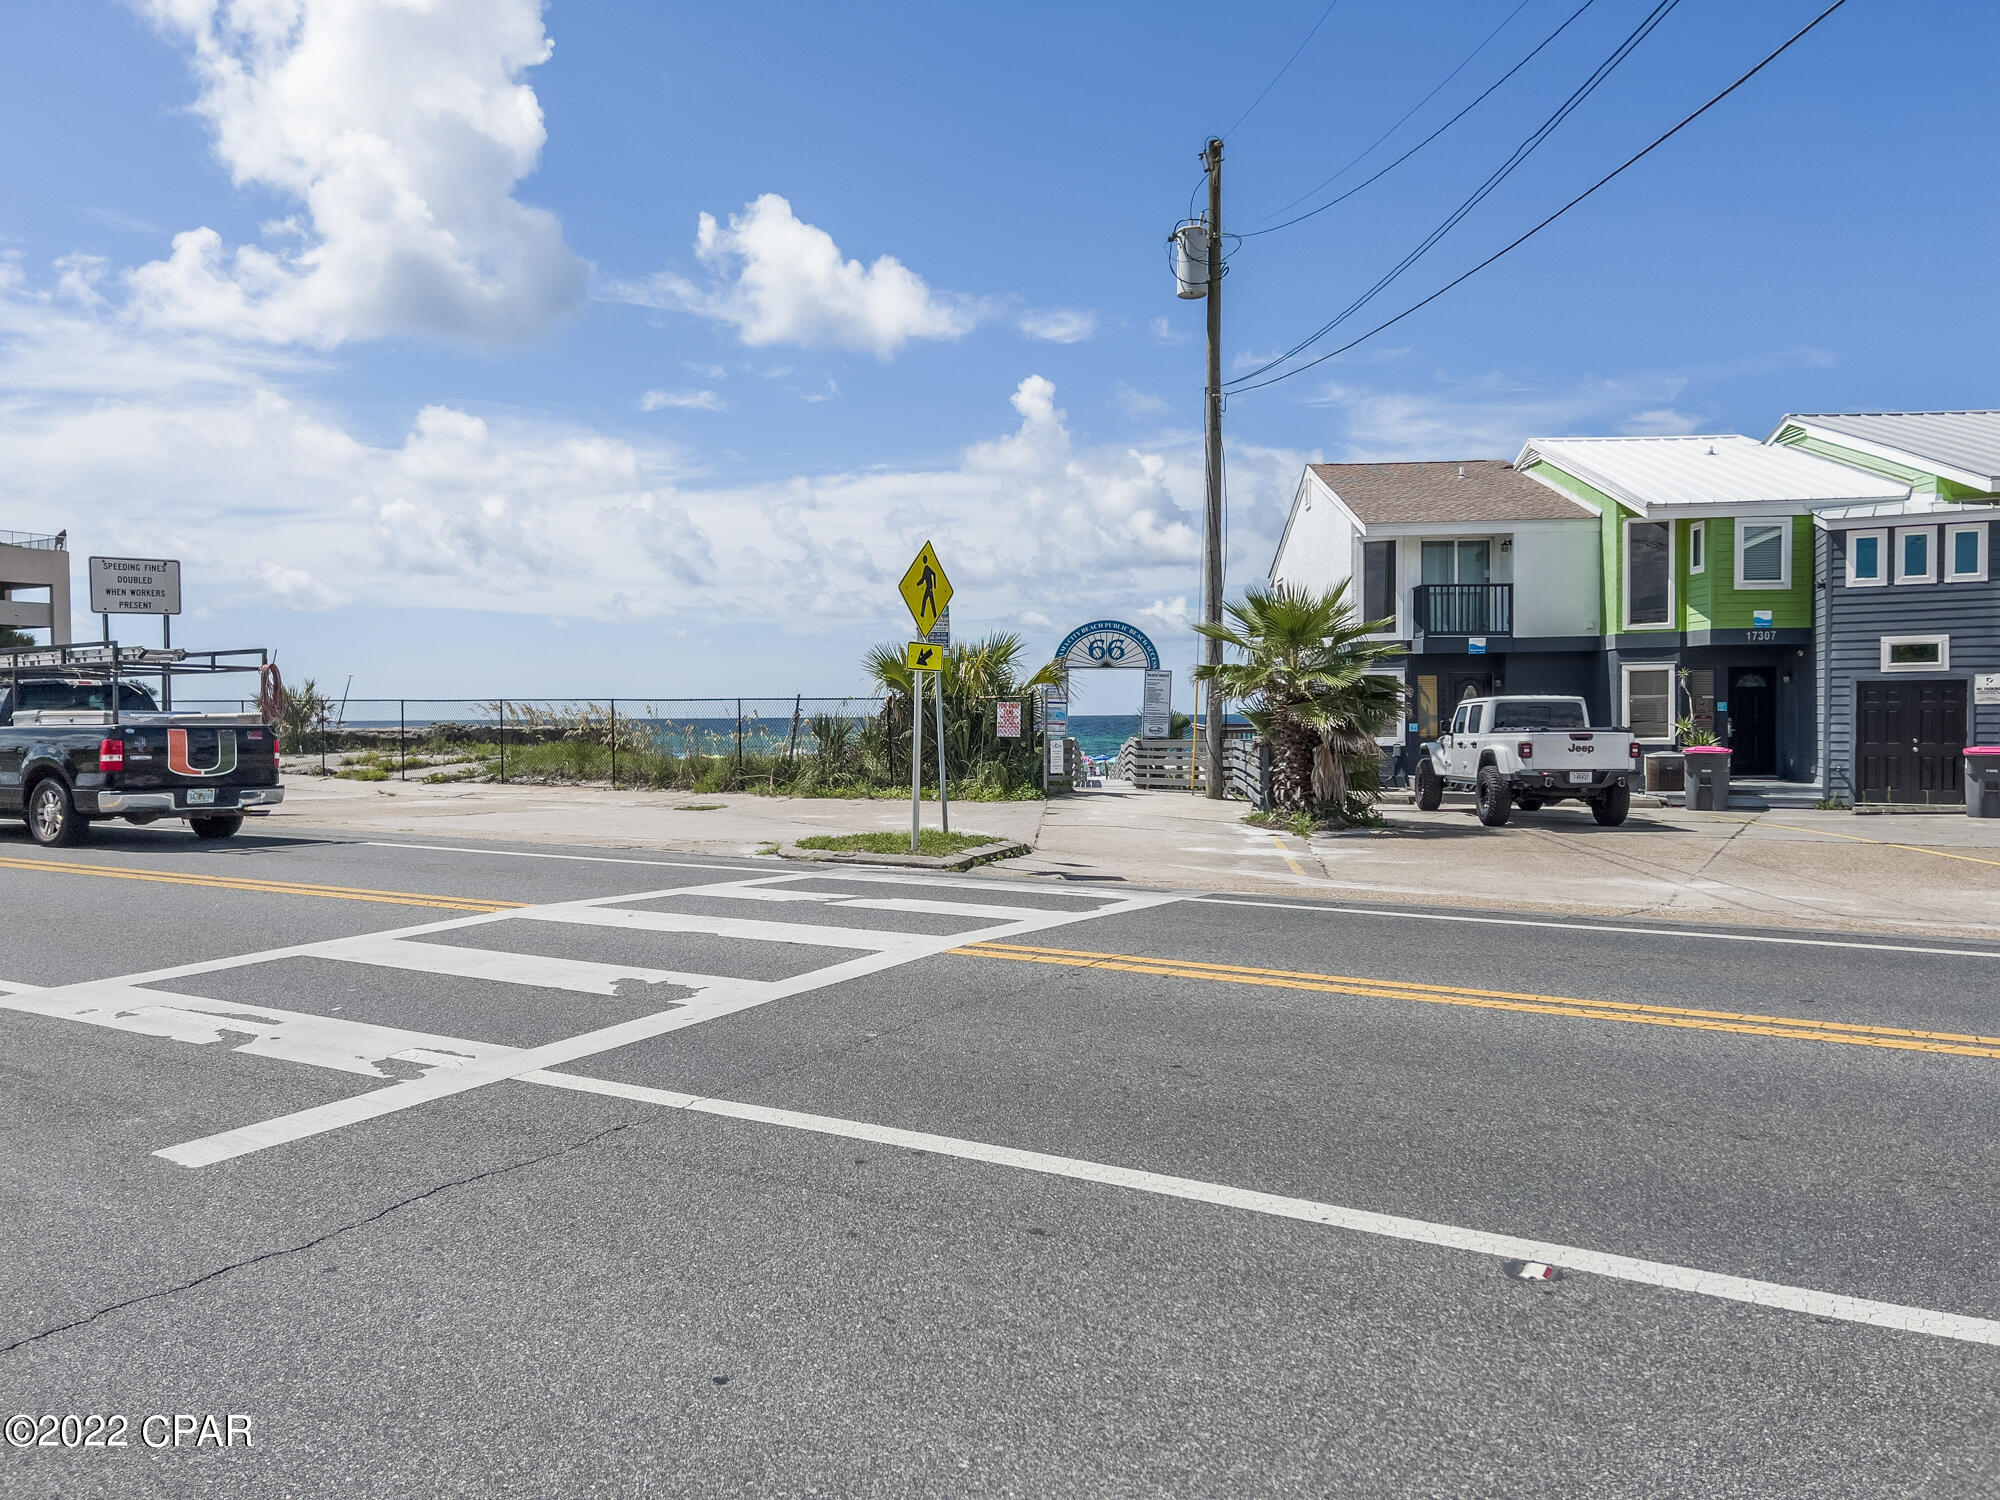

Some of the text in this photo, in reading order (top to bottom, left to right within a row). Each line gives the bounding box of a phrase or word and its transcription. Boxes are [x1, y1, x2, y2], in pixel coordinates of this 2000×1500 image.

[103, 563, 166, 572] SPEEDING FINES
[117, 576, 153, 584] DOUBLED
[105, 588, 166, 597] WHEN WORKERS
[119, 601, 152, 609] PRESENT
[1081, 623, 1104, 633] BEACH
[1104, 623, 1127, 631] PUBLIC
[1746, 630, 1776, 641] 17307
[1088, 639, 1125, 661] 66
[167, 728, 238, 778] U
[1568, 743, 1595, 754] Jeep
